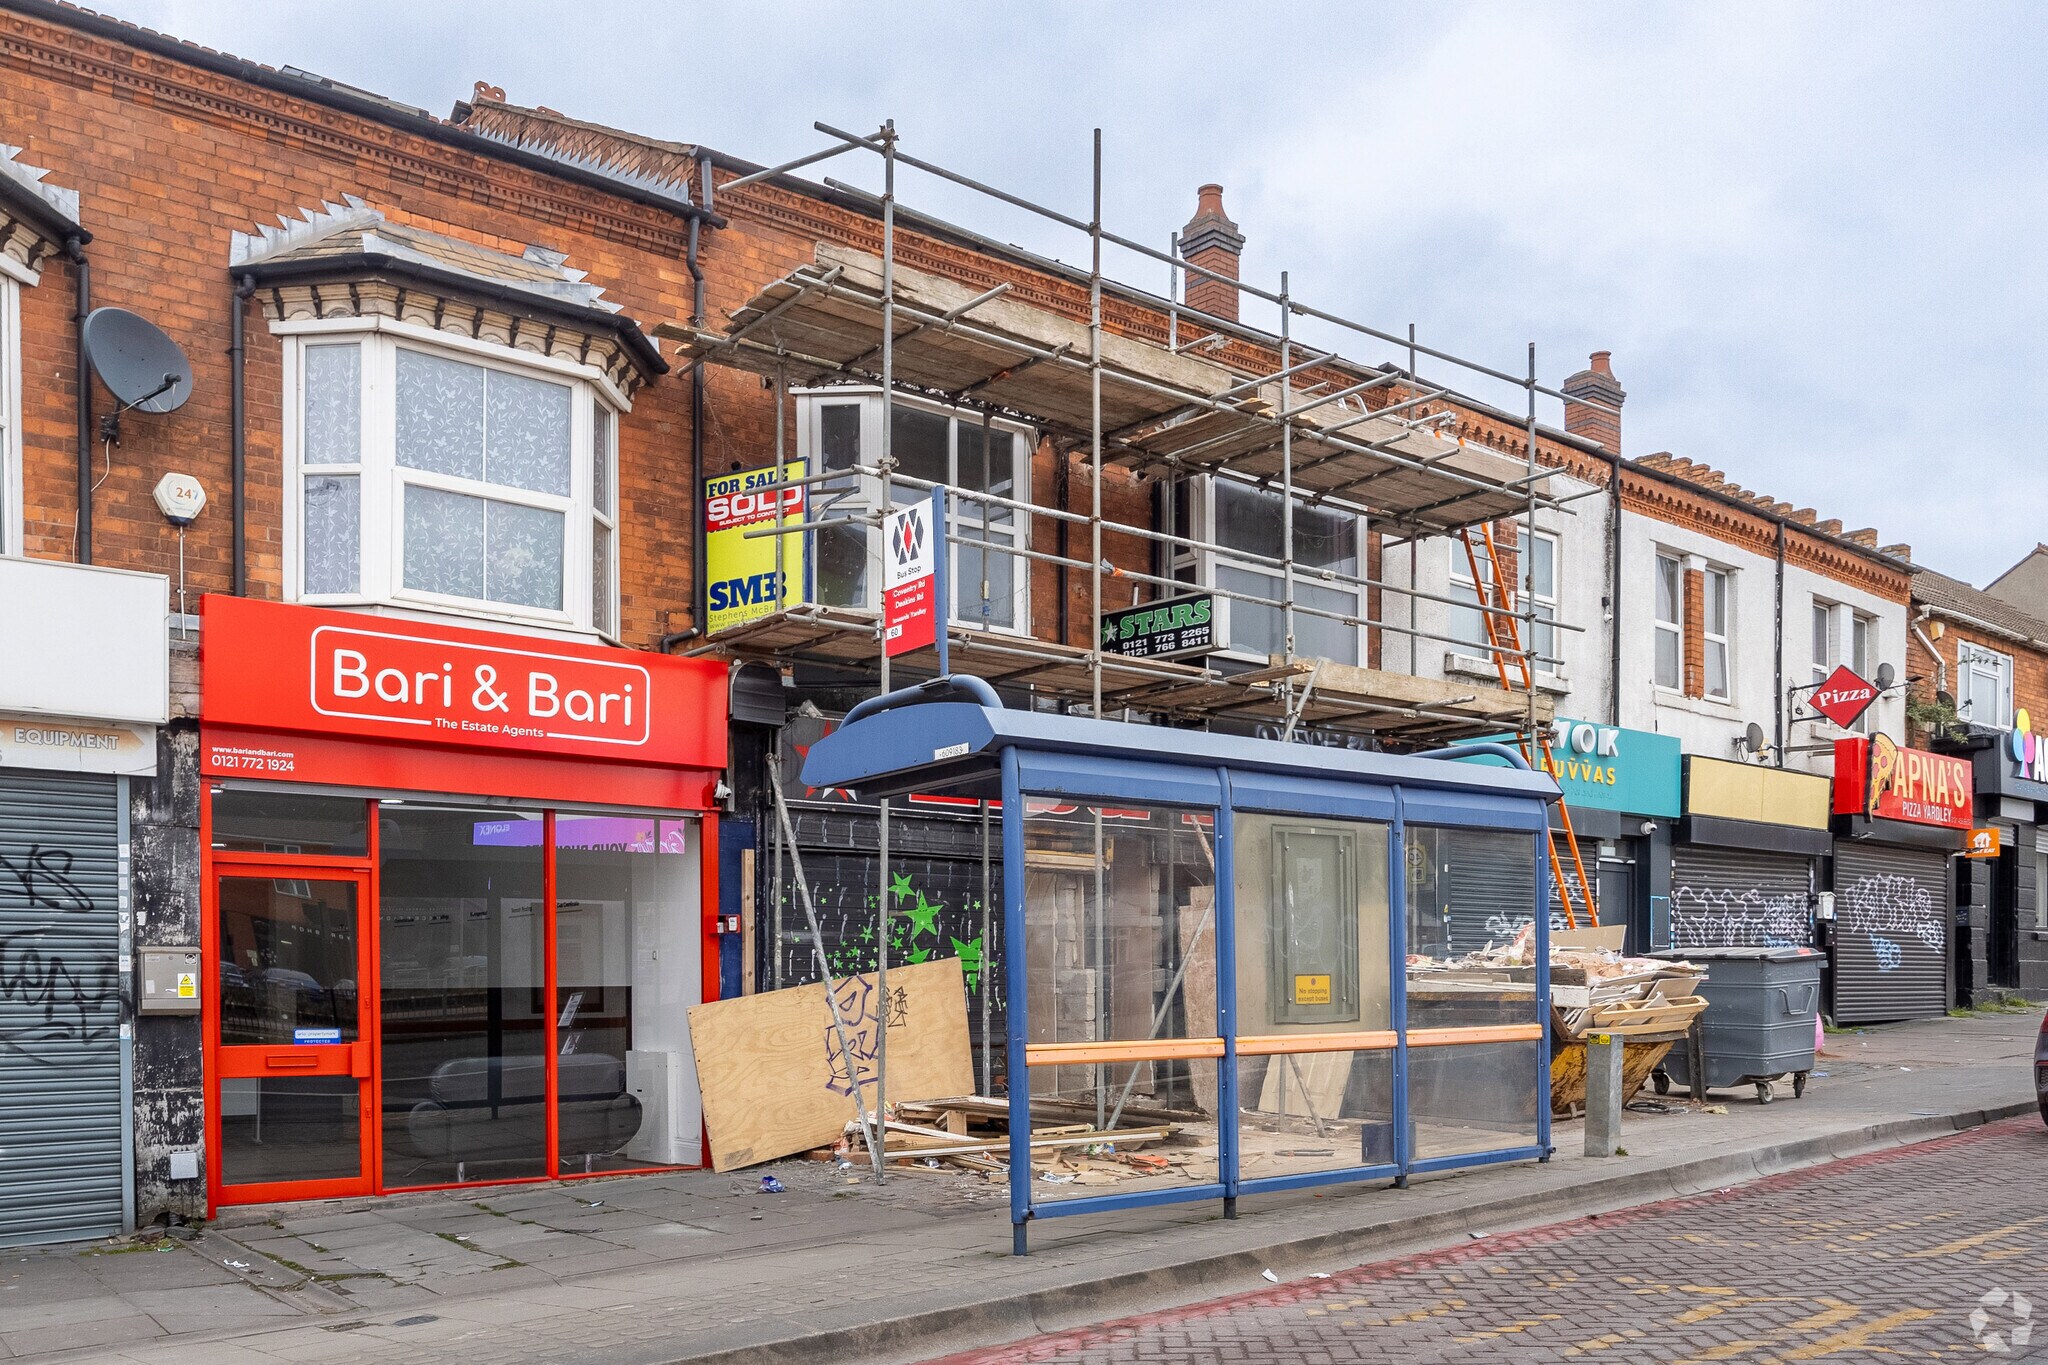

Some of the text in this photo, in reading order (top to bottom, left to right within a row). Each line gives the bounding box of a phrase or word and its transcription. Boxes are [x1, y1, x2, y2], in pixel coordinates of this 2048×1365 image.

[708, 478, 740, 498] FOR
[708, 485, 803, 522] SOLD
[719, 515, 746, 526] SUBJECT
[756, 507, 791, 518] CONTRCT
[896, 565, 922, 580] Bus Stop
[709, 571, 788, 612] SMB
[893, 579, 926, 598] Coventry Rd
[916, 592, 924, 601] Rd
[708, 603, 787, 623] Stephens McBre
[1120, 599, 1211, 640] STARS
[890, 627, 899, 637] 60
[1122, 626, 1210, 650] 0121 773 2265
[1123, 647, 1148, 657] 0121
[1154, 642, 1176, 653] 766
[1181, 636, 1209, 647] 8411
[333, 648, 632, 726] Bari & Bari
[1818, 686, 1871, 707] Pizza
[435, 717, 544, 738] The Estate Agents
[14, 727, 119, 750] EQUIPMENT
[211, 746, 294, 758] www.bariandbari.com
[211, 754, 295, 771] 0121 772 1924
[1893, 751, 1965, 808] APNA'S
[1902, 801, 1921, 818] PIZZA
[1923, 804, 1953, 823] YARDLEY
